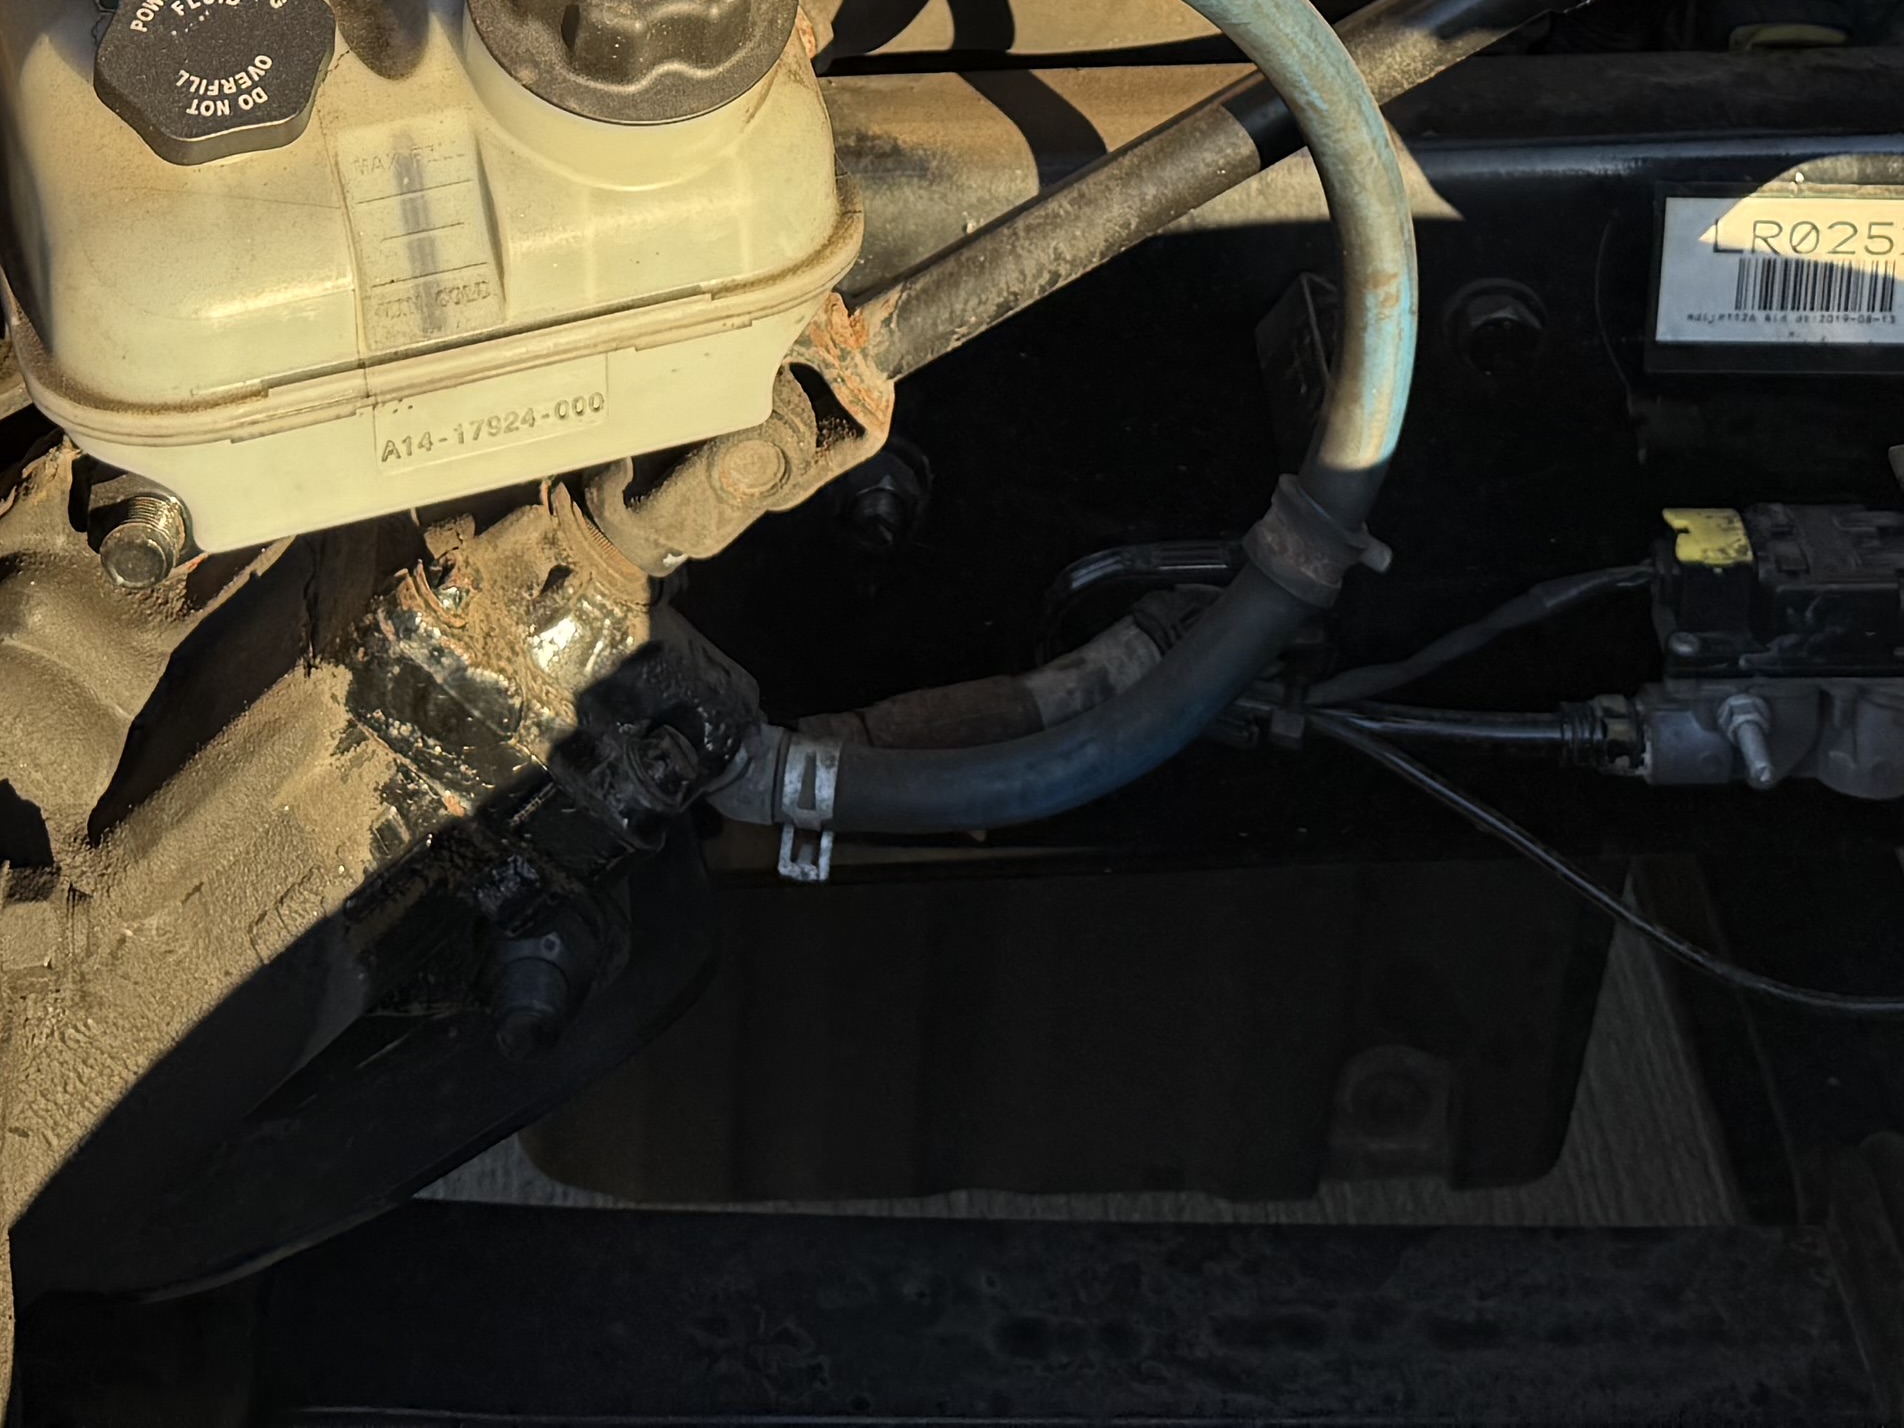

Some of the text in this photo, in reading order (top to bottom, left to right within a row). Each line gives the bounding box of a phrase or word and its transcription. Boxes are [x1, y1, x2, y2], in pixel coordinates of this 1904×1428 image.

[175, 54, 274, 97] OVERFILL
[185, 85, 269, 117] DO NOT
